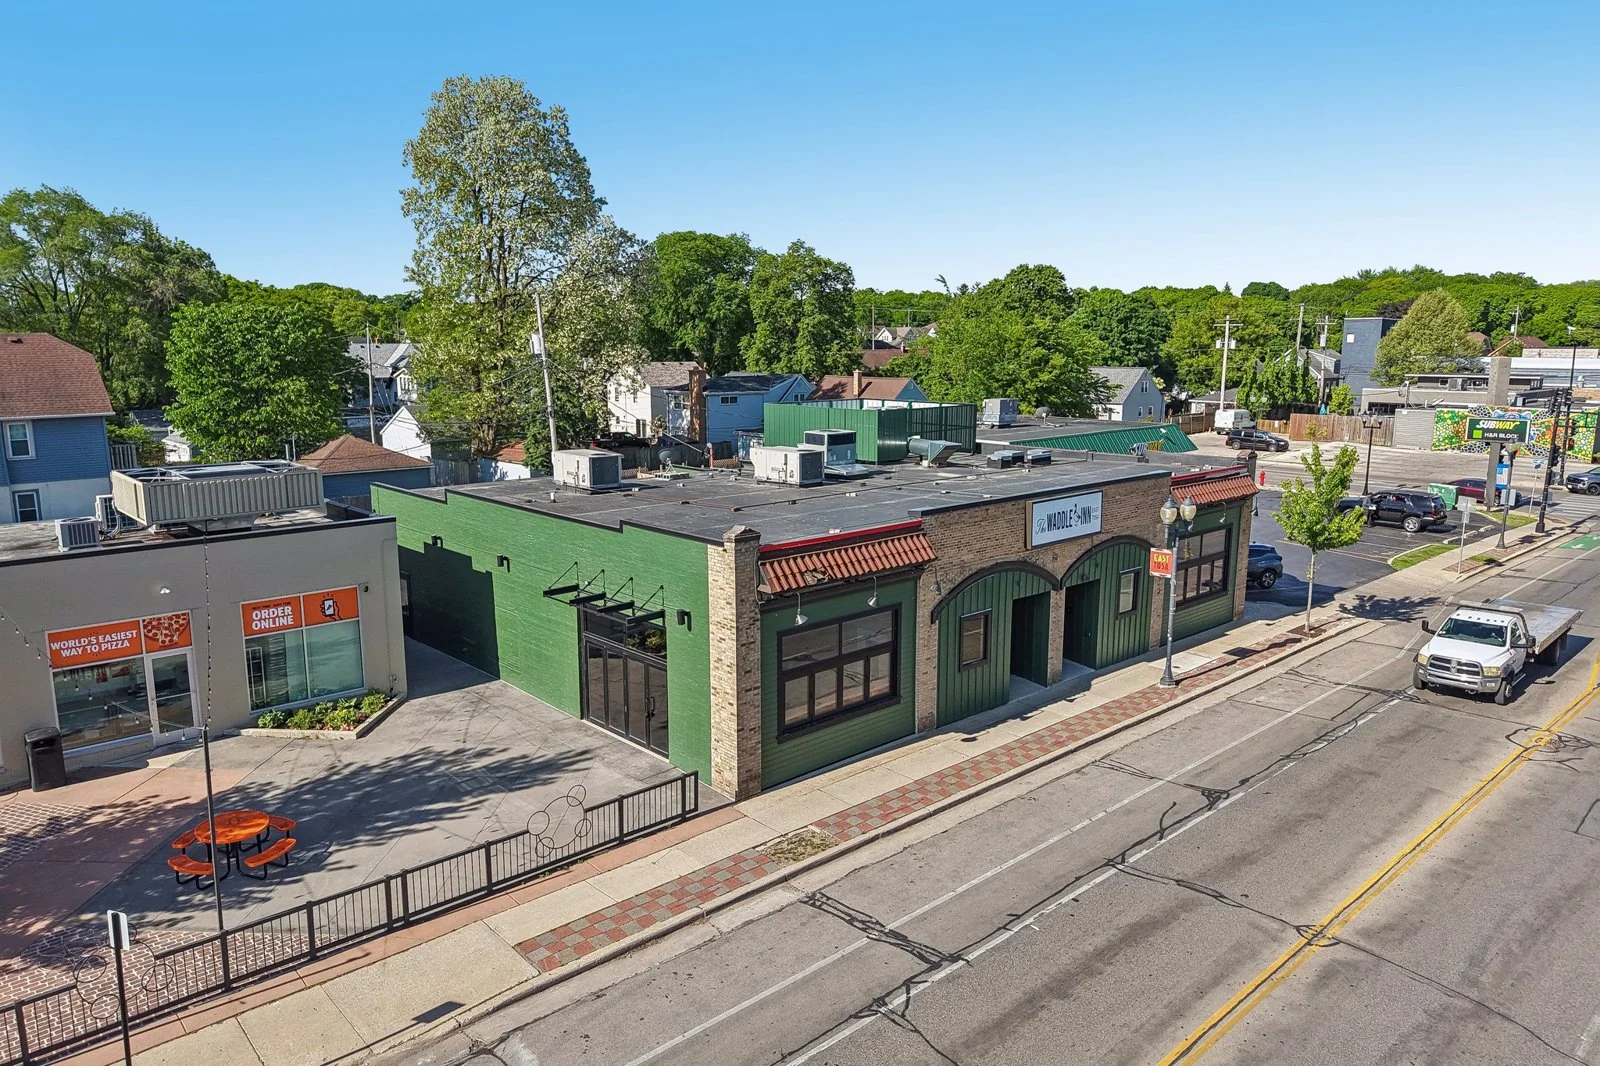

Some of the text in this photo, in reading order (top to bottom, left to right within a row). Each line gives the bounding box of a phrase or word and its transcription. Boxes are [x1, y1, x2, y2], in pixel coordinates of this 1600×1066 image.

[1475, 420, 1520, 429] SUBWAY
[1035, 505, 1092, 535] The WADDLE INN
[1153, 553, 1170, 563] EAST
[1153, 561, 1169, 571] TOSA
[252, 606, 292, 620] ORDER
[252, 615, 294, 630] ONLINE
[50, 630, 138, 651] WORLD'S EASIEST
[60, 640, 131, 657] WAY TO PIZZA
